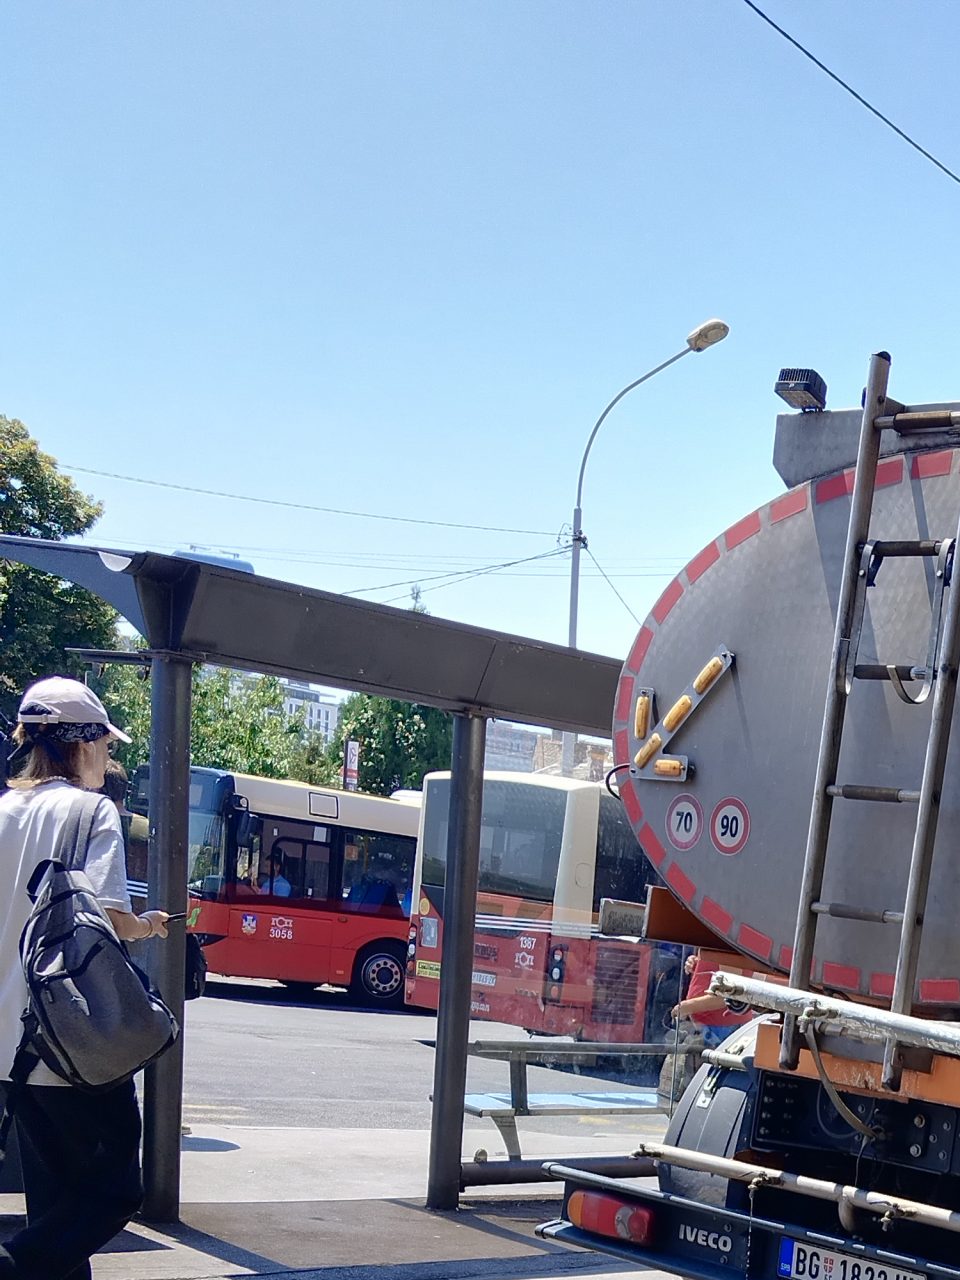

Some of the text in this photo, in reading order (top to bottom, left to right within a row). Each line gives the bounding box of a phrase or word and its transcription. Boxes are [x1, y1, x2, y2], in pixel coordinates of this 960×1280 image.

[676, 811, 693, 834] 70
[720, 814, 739, 838] 90
[269, 928, 293, 940] 3058
[678, 1223, 733, 1253] IVECO
[795, 1247, 821, 1280] BG
